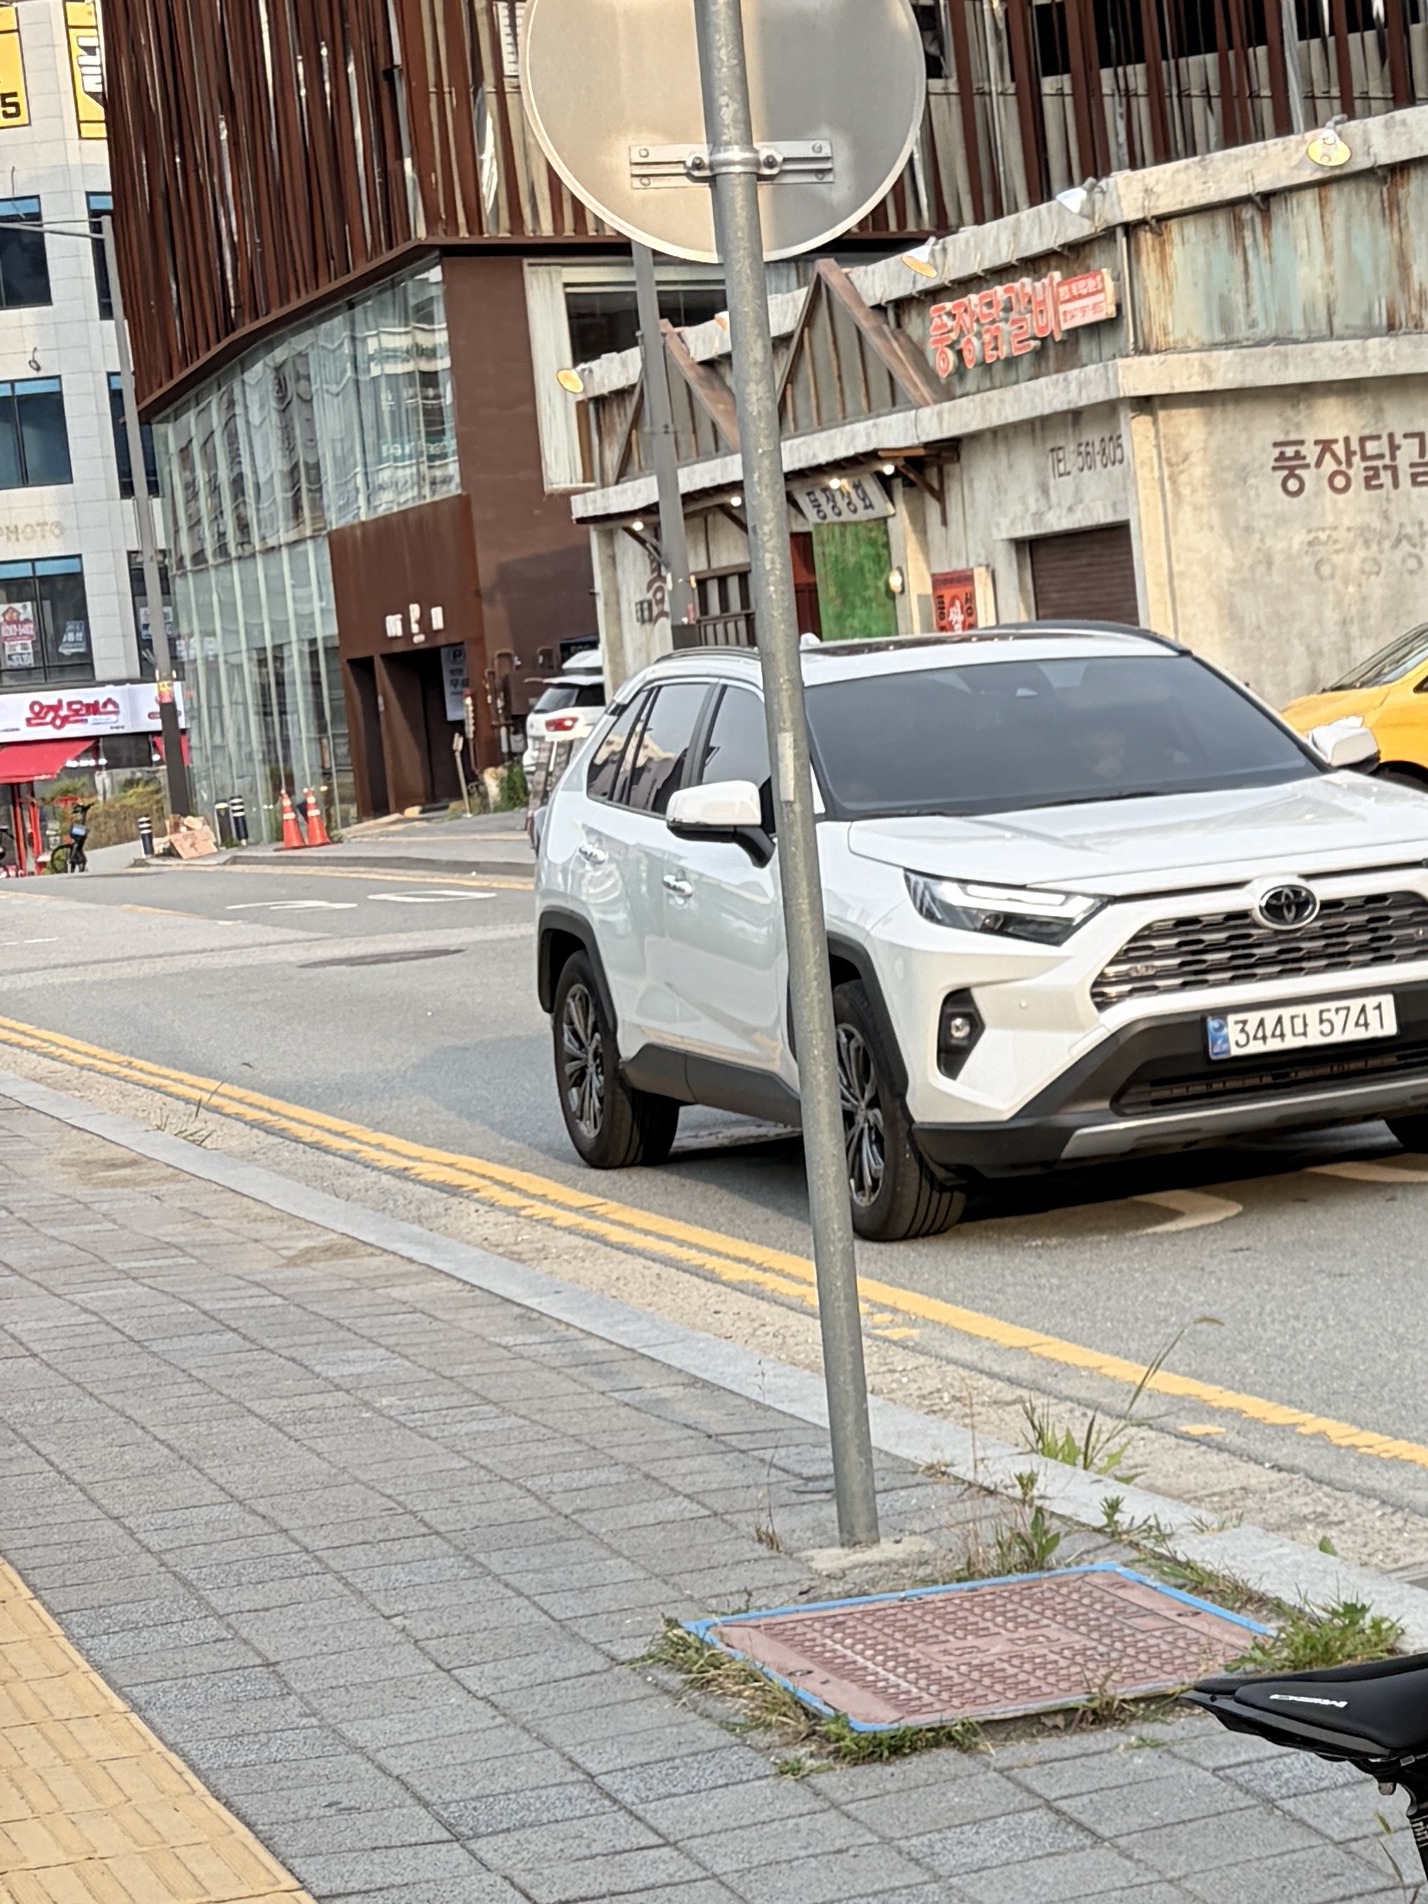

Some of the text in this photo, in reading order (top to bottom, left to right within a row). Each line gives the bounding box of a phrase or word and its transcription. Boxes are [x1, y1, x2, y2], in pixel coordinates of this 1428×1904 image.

[929, 270, 1063, 379] 풍장닭갈비
[0, 520, 66, 543] HOTO
[1318, 1001, 1387, 1038] 5741
